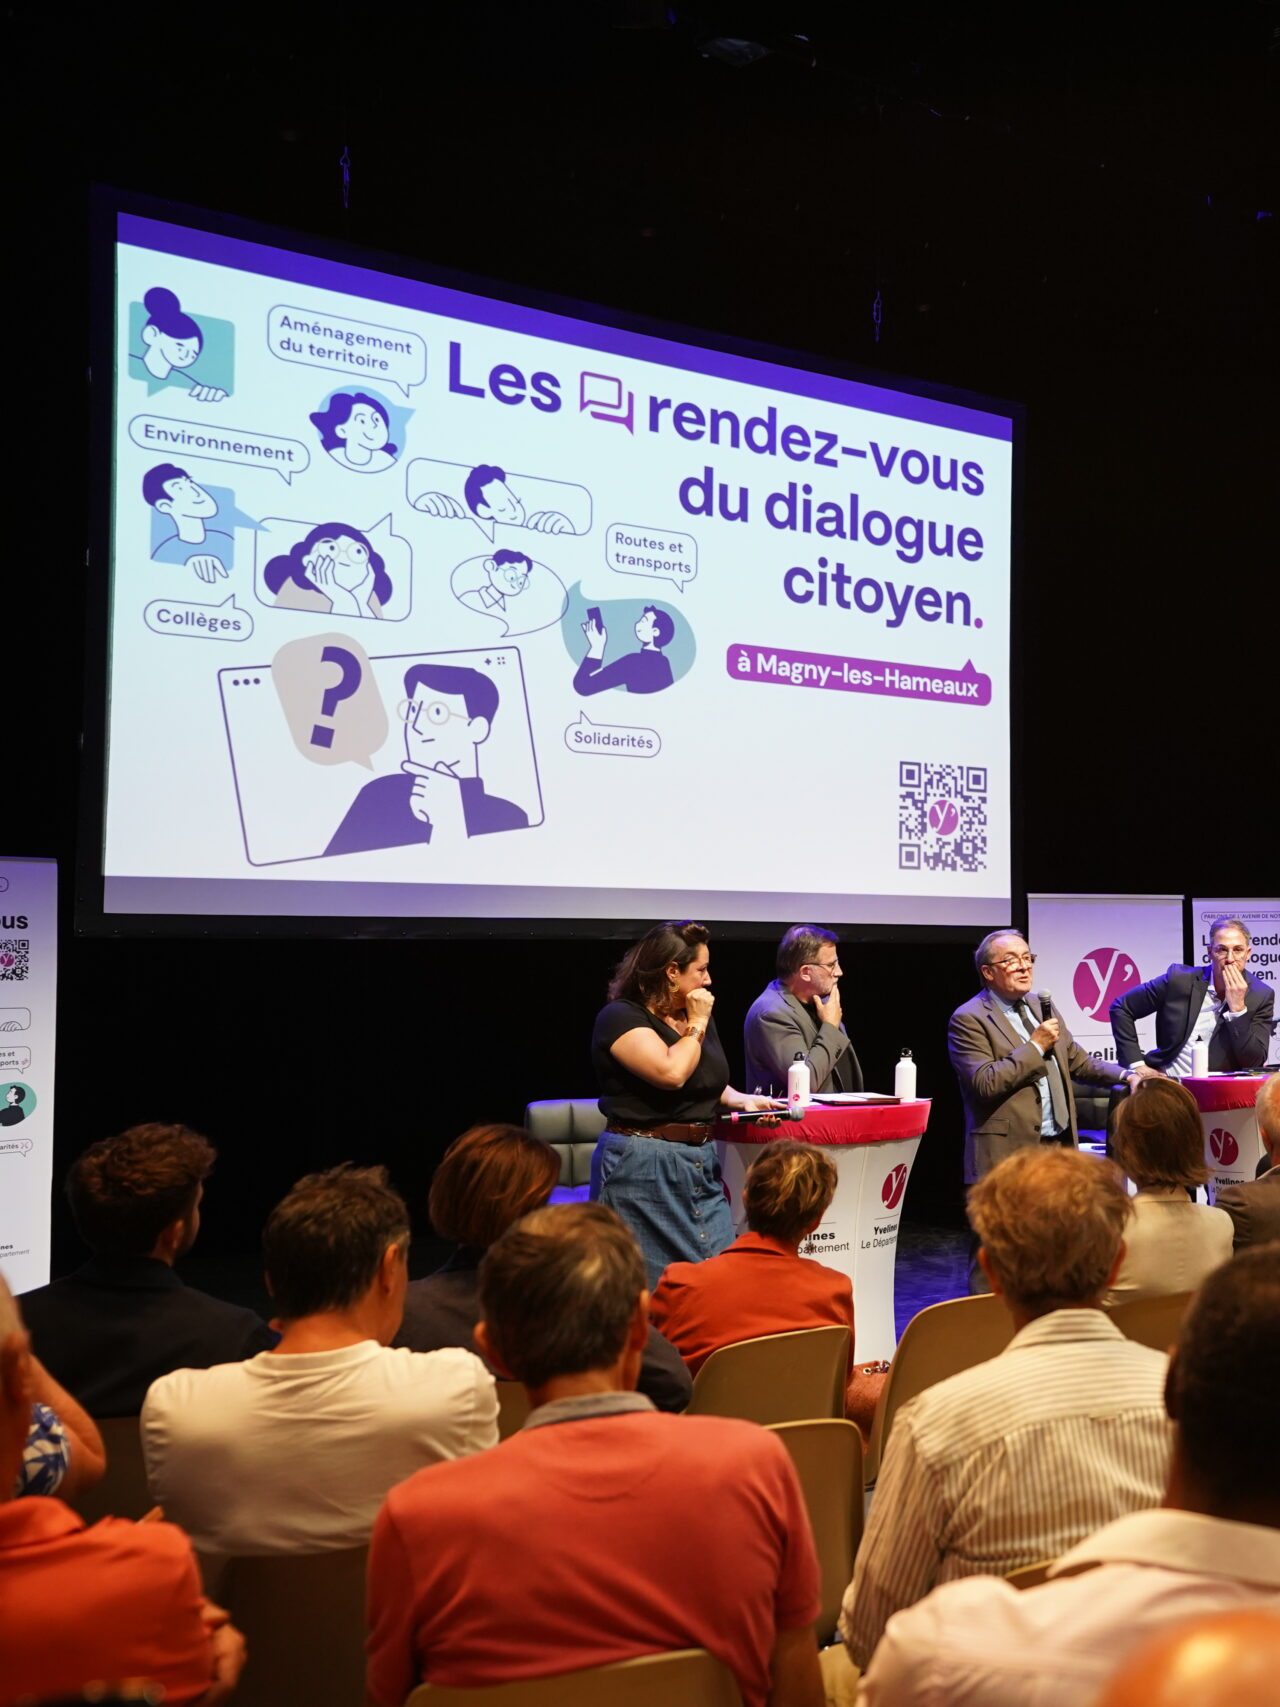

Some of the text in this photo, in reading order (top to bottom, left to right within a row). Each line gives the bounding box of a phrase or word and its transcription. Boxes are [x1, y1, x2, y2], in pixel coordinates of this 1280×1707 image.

[280, 315, 412, 355] Aménagement
[280, 337, 389, 371] du territoire
[449, 341, 985, 496] Les rendez-vous
[143, 423, 294, 462] Environnement
[679, 466, 984, 562] du dialogue
[615, 531, 683, 554] Routes et
[615, 552, 692, 573] transports
[783, 557, 984, 629] citoyen.
[156, 608, 242, 633] Collèges
[737, 650, 980, 698] à Magny-les-Hameaux
[574, 730, 654, 751] Solidarités
[860, 1239, 871, 1249] Le
